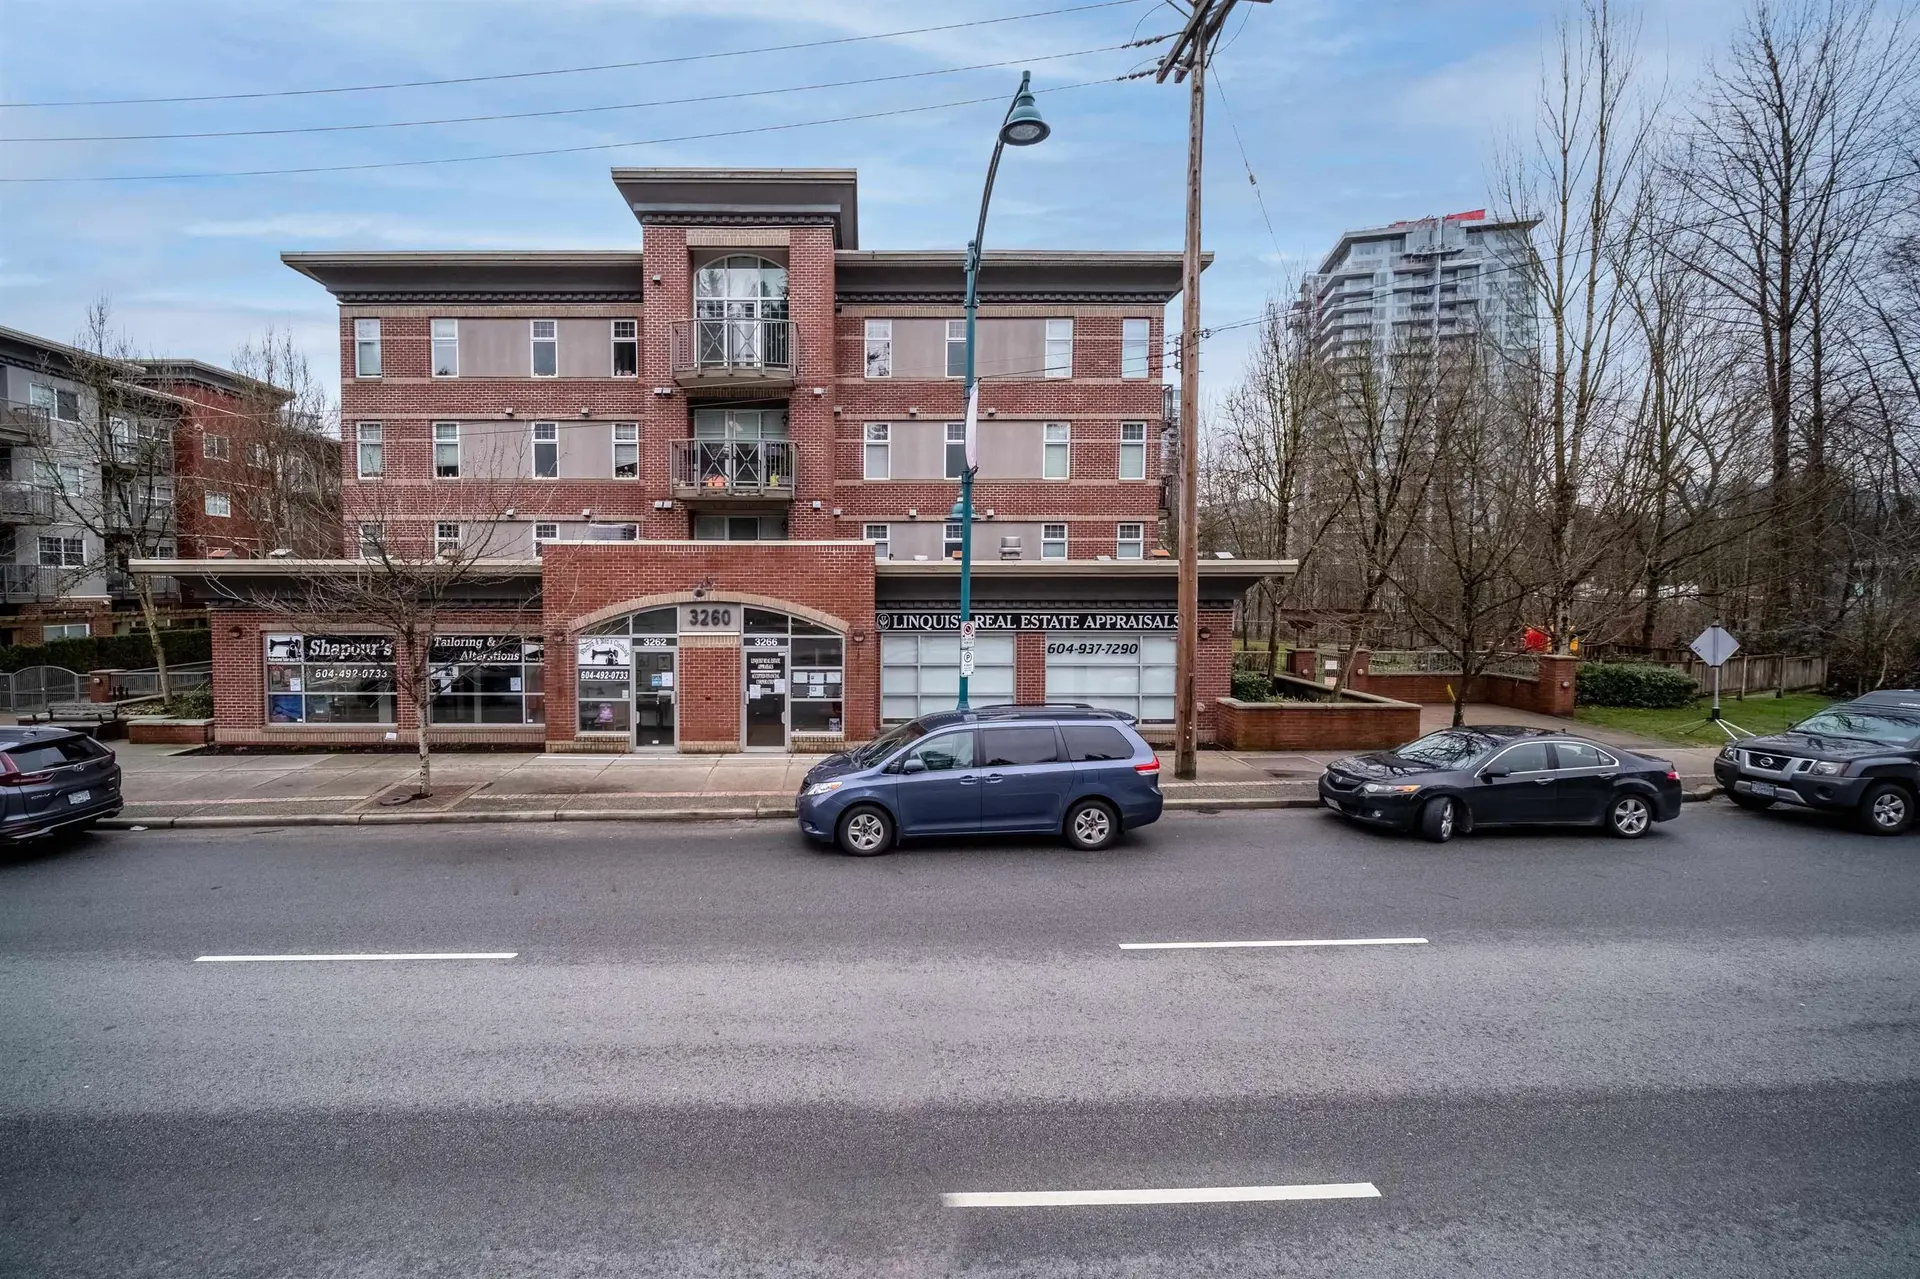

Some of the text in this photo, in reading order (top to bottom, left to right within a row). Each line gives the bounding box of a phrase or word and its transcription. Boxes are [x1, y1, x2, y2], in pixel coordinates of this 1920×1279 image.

[690, 609, 731, 626] 3260
[893, 615, 961, 630] LINQUIS
[974, 615, 1017, 629] REAL
[1020, 615, 1080, 629] ESTATE
[434, 636, 496, 648] Tailoring &
[644, 638, 667, 646] 3262
[754, 638, 778, 646] 3266
[309, 639, 393, 659] Shapour's
[1047, 643, 1138, 655] 604-937-7290
[315, 669, 388, 678] 604-492-0733
[581, 671, 628, 679] 604-492-0733
